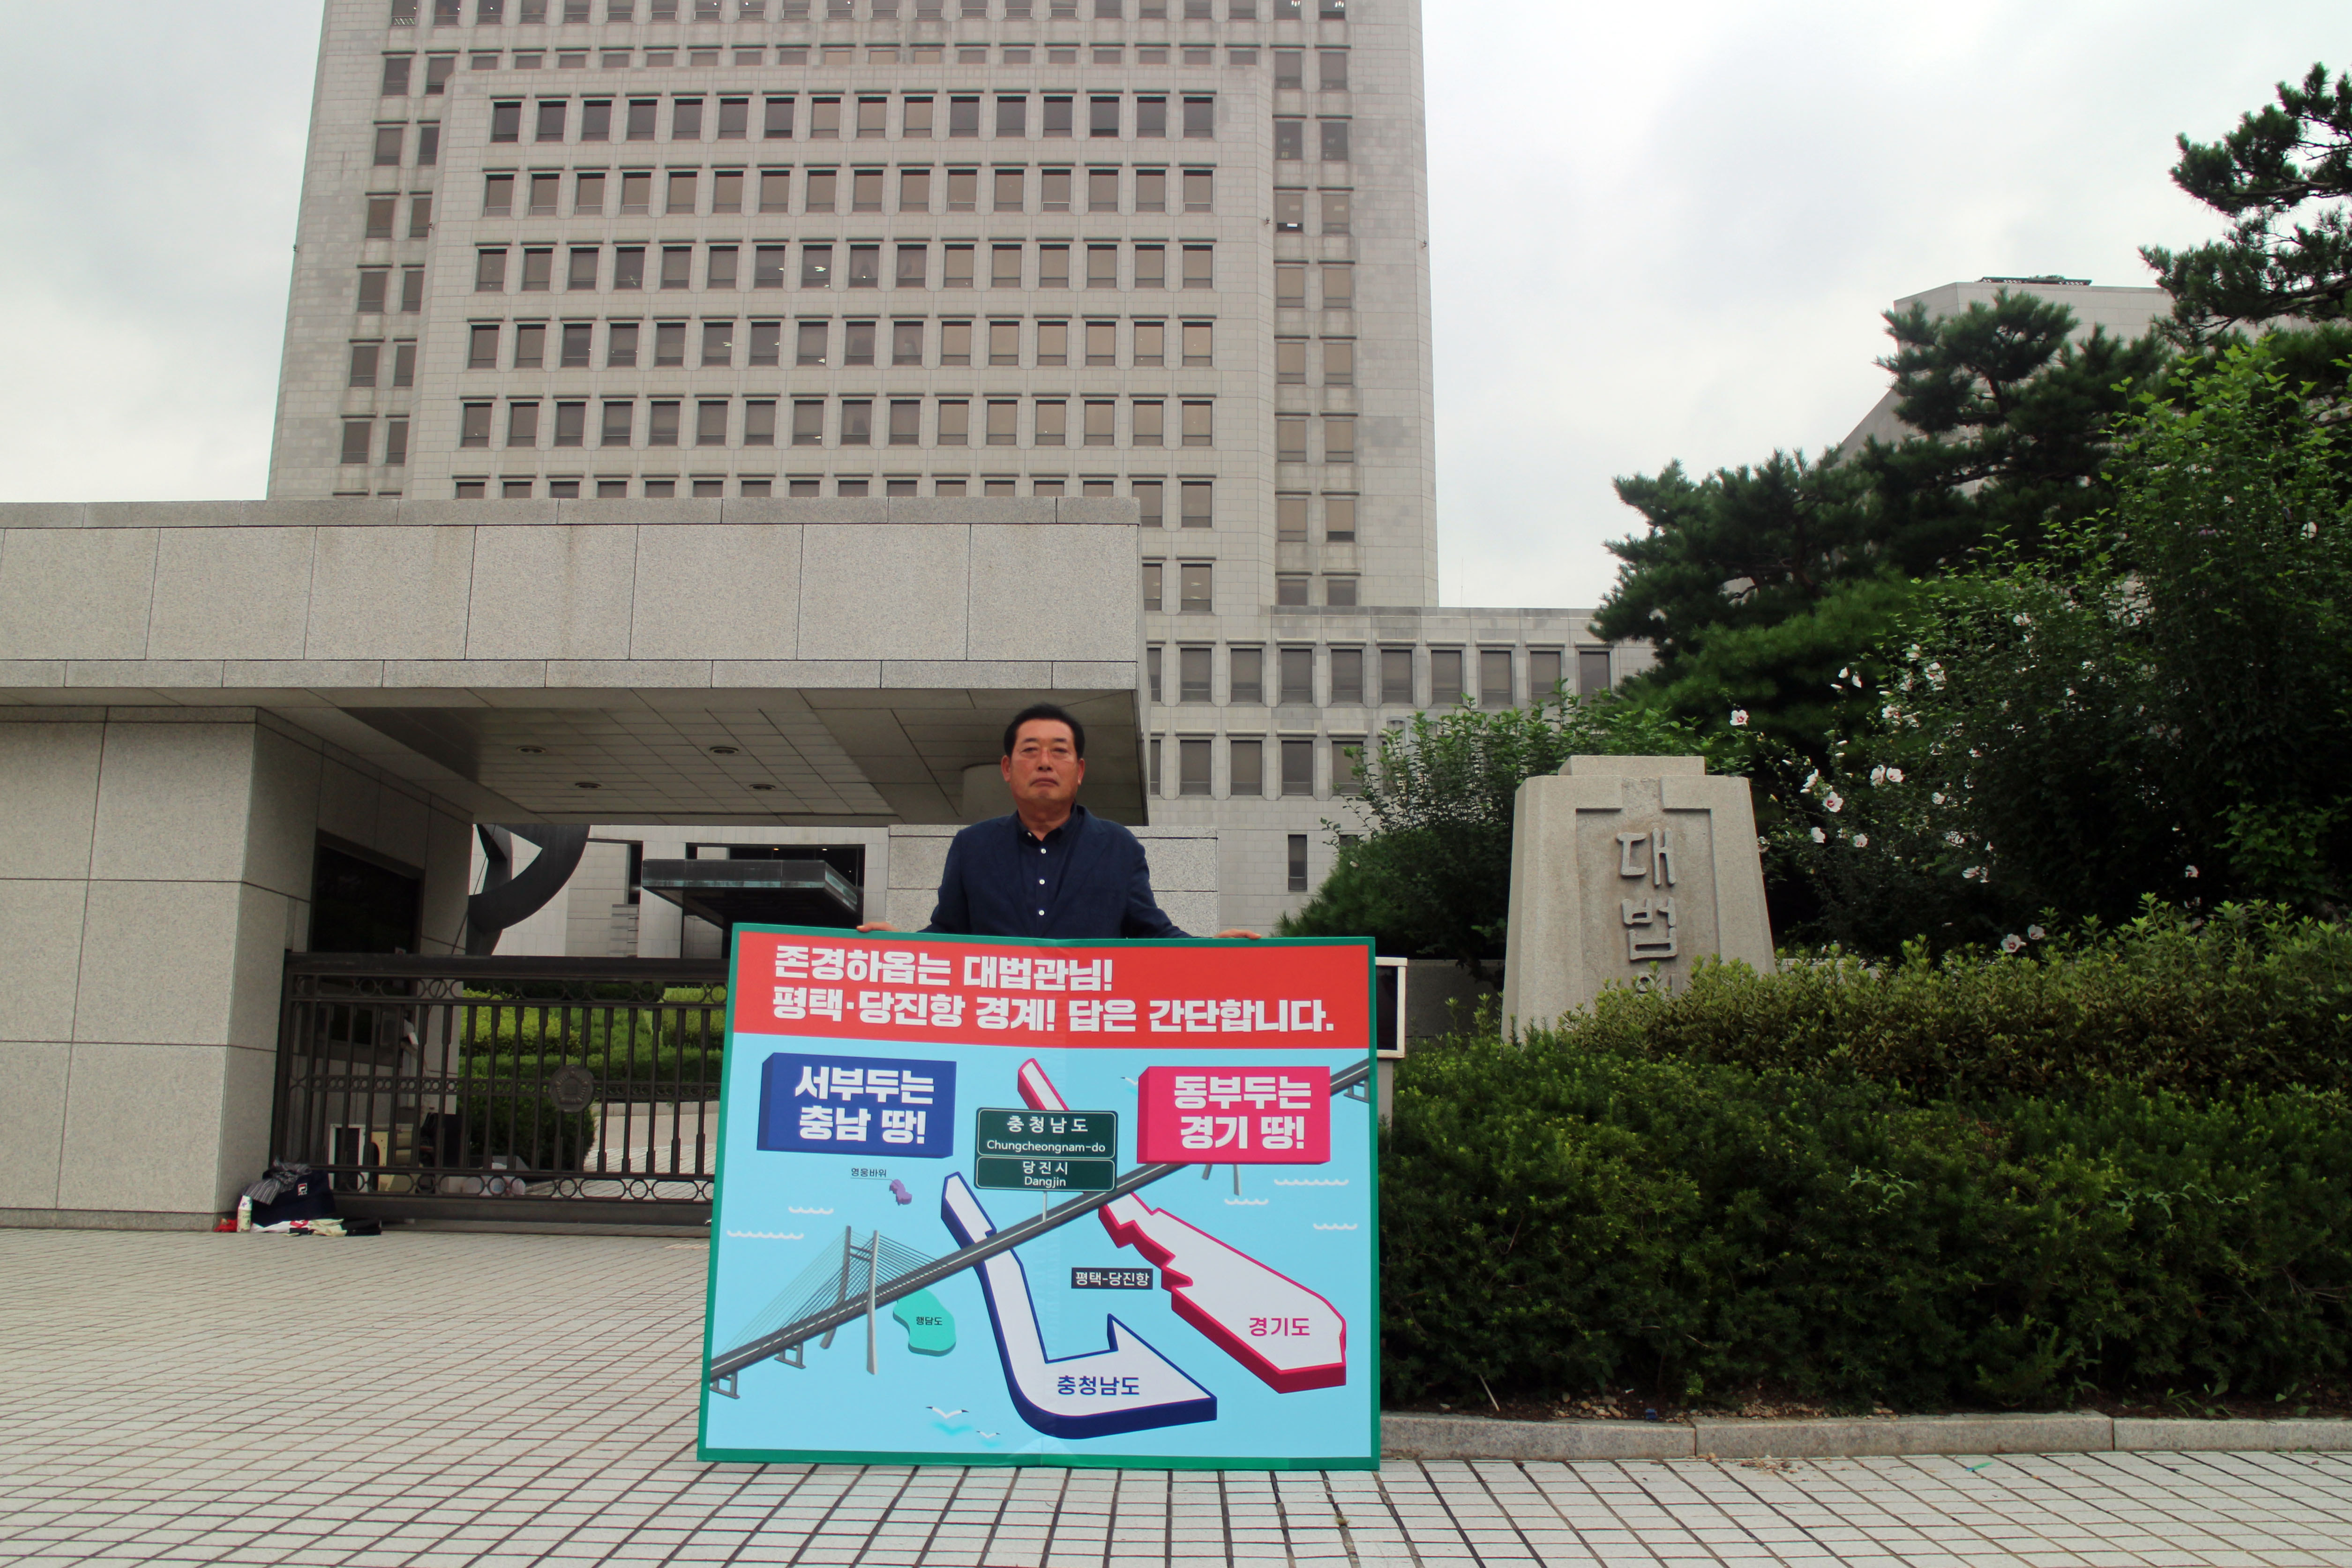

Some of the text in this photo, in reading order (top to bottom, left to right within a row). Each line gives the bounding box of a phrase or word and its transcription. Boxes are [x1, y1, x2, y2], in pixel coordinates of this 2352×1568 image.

[775, 945, 1113, 991] 존경하옵는 대법관님!
[773, 986, 1334, 1032] 평택·당진항 경계! 답은 간단합니다.
[795, 1065, 935, 1104] 서부두는
[1174, 1076, 1312, 1110] 동부두는
[799, 1105, 927, 1144] 충남 땅!
[1007, 1115, 1088, 1133] 충청남도
[1180, 1116, 1305, 1149] 경기 땅!
[987, 1140, 1106, 1154] Chungcheongnam-do
[851, 1168, 887, 1178] 영웅바위
[1023, 1161, 1068, 1175] 당진시
[1024, 1176, 1066, 1189] Dangjin
[1075, 1271, 1150, 1287] 평택-당진항
[916, 1316, 943, 1326] 행담도
[1249, 1317, 1311, 1336] 경기도
[1057, 1375, 1140, 1395] 충청남도
